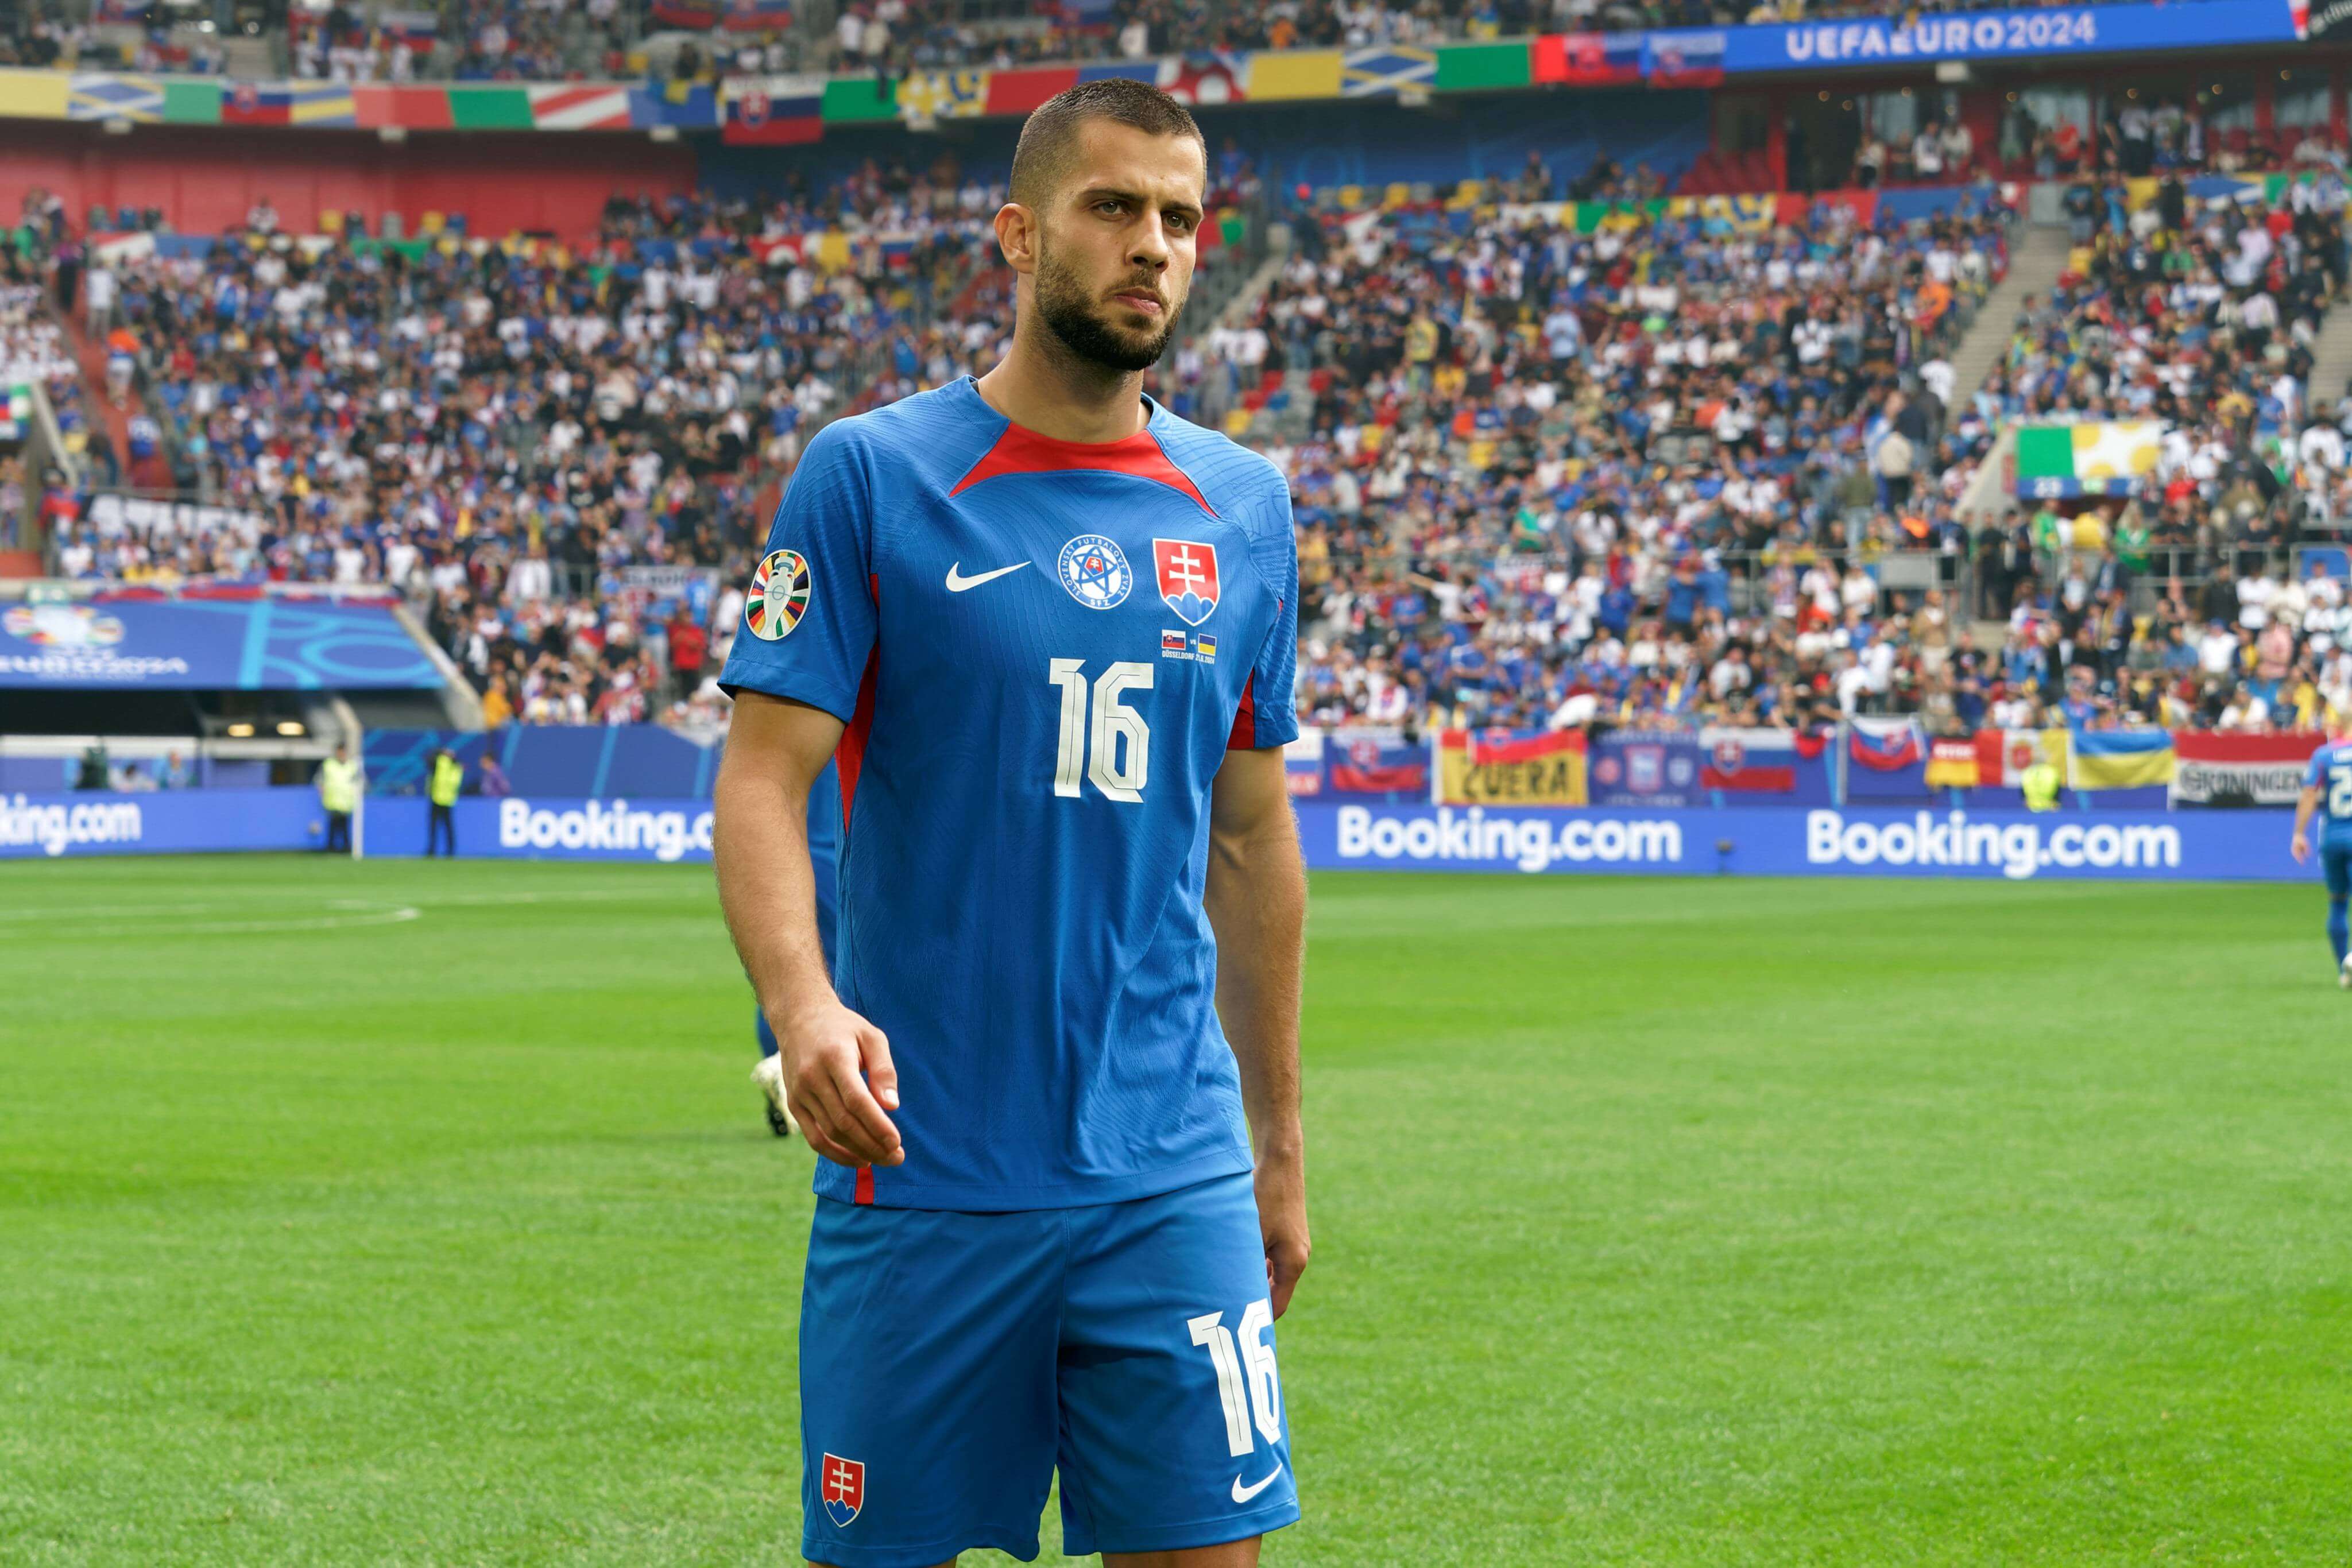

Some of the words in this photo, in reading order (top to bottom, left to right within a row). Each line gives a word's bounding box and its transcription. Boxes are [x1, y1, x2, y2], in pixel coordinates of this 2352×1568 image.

[1090, 599, 1111, 607] SFZ
[1162, 649, 1195, 660] DÜSSELDORF
[1049, 657, 1154, 803] 16
[1337, 805, 1683, 873] Booking.com
[1806, 809, 2181, 880] Booking.com
[1187, 1298, 1282, 1457] 16
